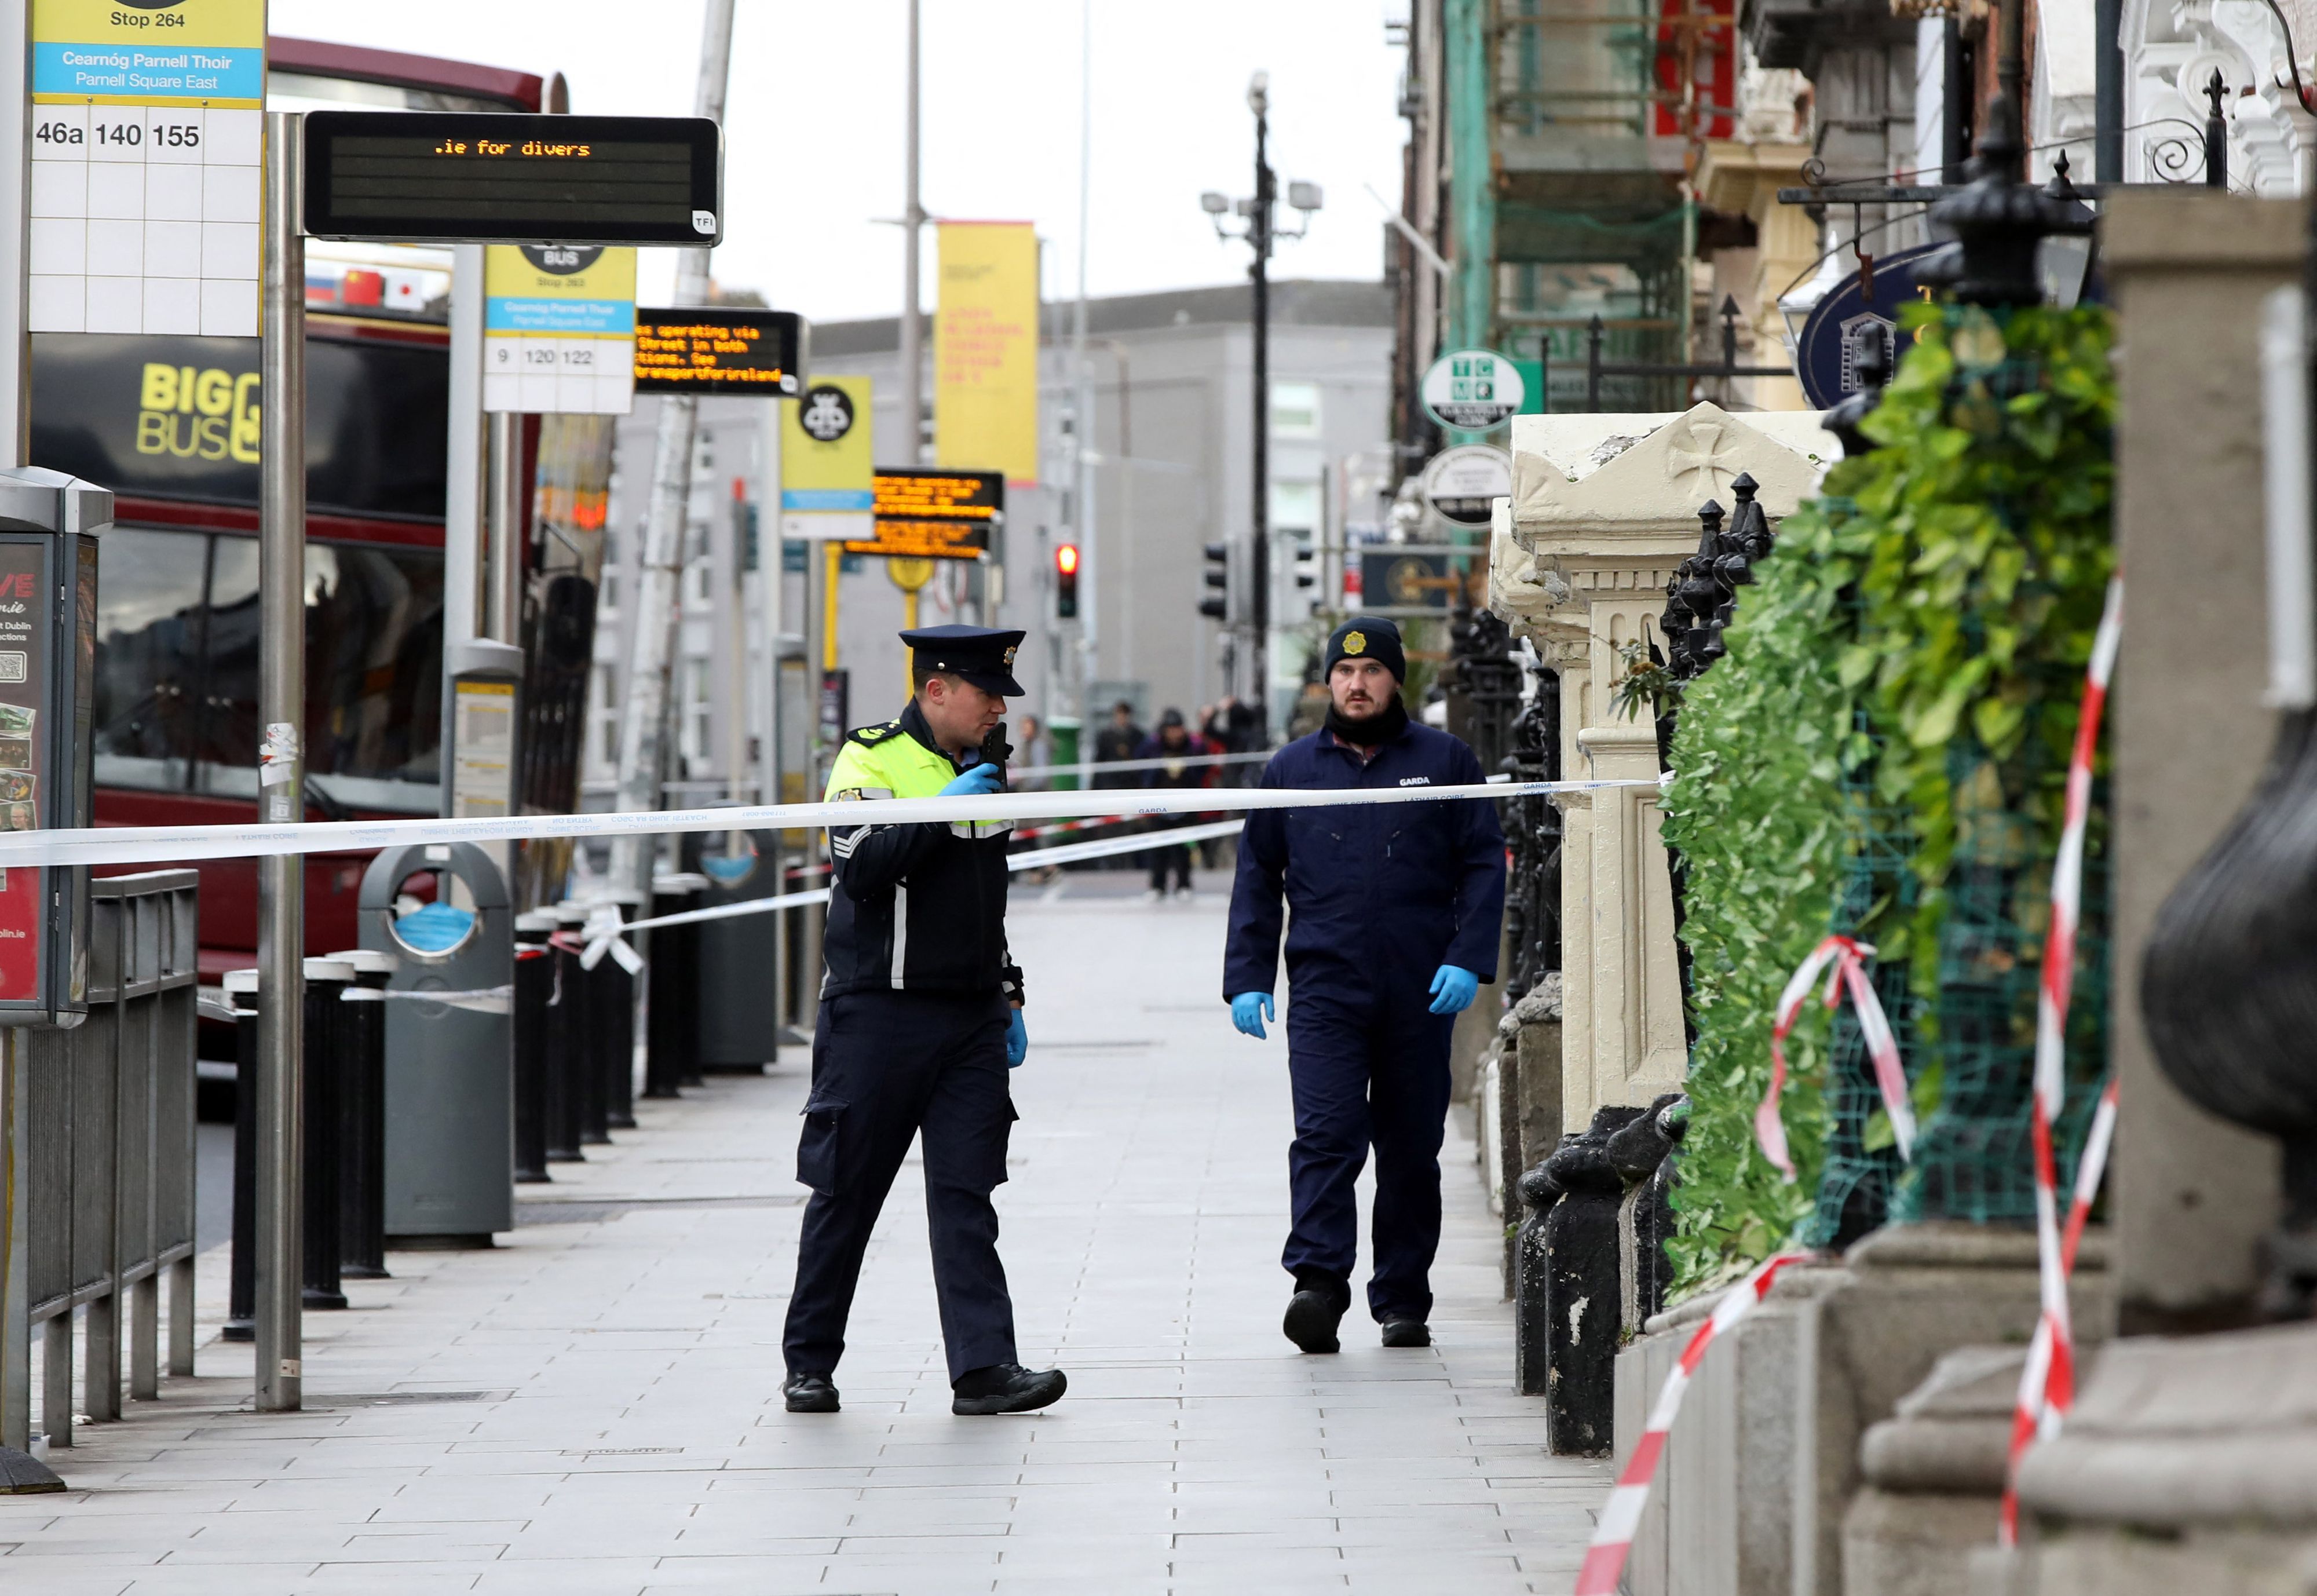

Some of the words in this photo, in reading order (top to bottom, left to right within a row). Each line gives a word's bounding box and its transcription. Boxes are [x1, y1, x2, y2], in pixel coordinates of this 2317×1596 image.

[111, 12, 149, 28] Stop
[155, 14, 185, 27] 264
[63, 51, 129, 69] Cearnóg
[134, 53, 187, 68] Parnell
[191, 55, 232, 69] Thoir
[76, 72, 125, 86] Parnell
[129, 73, 181, 90] Square
[186, 75, 218, 89] East
[36, 122, 83, 144] 46a
[96, 124, 141, 145] 140
[153, 125, 199, 147] 155
[436, 138, 466, 154] .ie
[477, 140, 511, 155] for
[521, 141, 590, 156] divers
[695, 218, 713, 226] TFI
[543, 251, 579, 266] BUS
[657, 325, 730, 340] operating
[733, 326, 760, 339] via
[638, 337, 687, 351] Street
[693, 338, 710, 352] in
[714, 339, 748, 353] both
[498, 349, 508, 362] 9
[526, 350, 555, 363] 120
[563, 350, 593, 364] 122
[691, 352, 717, 366] See
[141, 363, 235, 417] BIG
[136, 410, 229, 461] BUS
[5, 622, 31, 630] Dublin
[1399, 776, 1430, 786] GARDA
